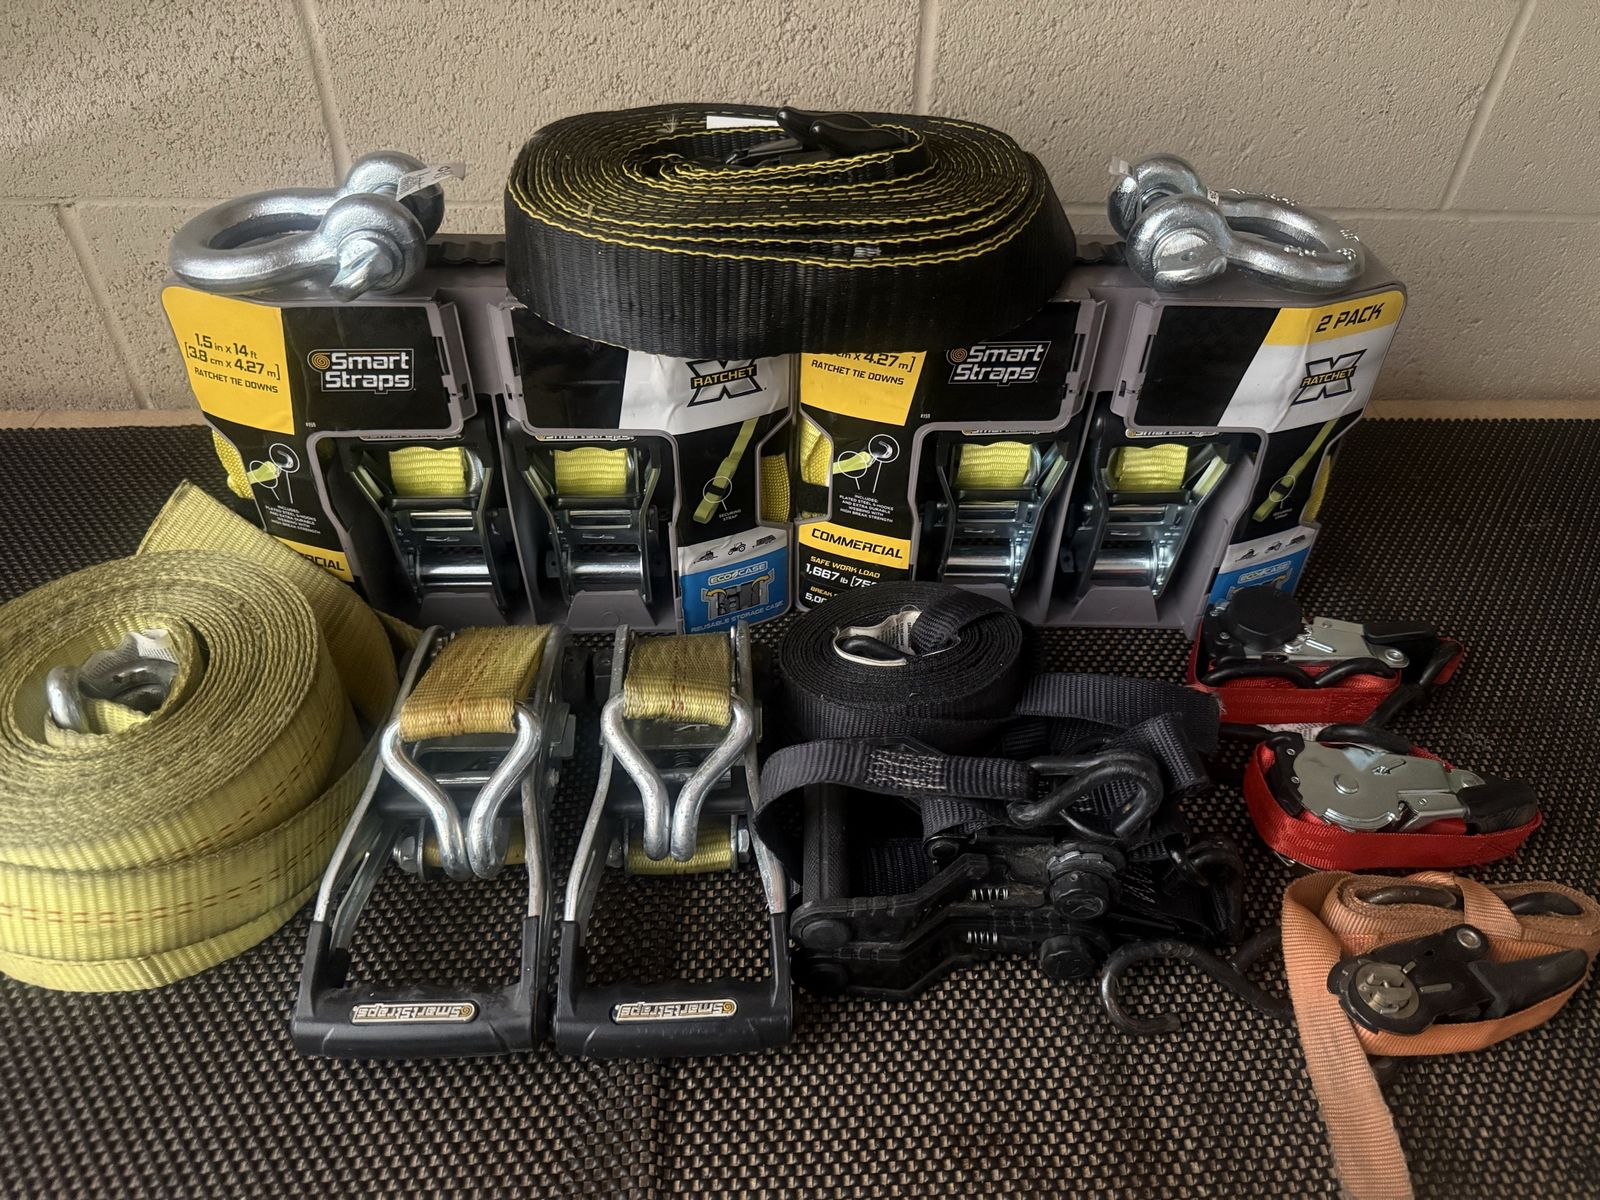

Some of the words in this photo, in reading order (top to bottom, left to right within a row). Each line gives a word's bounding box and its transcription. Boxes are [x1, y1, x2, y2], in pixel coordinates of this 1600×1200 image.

[1315, 314, 1333, 333] 2
[1333, 302, 1385, 330] PACK
[195, 333, 213, 349] 1.5
[214, 342, 224, 352] in
[233, 342, 249, 358] 14
[250, 350, 258, 360] ft
[966, 344, 1045, 362] Smart
[210, 358, 224, 367] cm
[234, 358, 265, 375] 4.27
[331, 352, 410, 370] Smart
[863, 352, 900, 368] 4.27
[194, 366, 228, 383] RATCHET
[229, 377, 243, 387] TIE
[244, 380, 279, 394] DOWNS
[325, 371, 410, 391] Straps
[693, 367, 755, 388] RATCHET
[811, 359, 851, 376] RATCHET
[852, 369, 865, 379] TIE
[867, 372, 905, 386] DOWNS
[953, 364, 1038, 383] Straps
[1302, 368, 1355, 387] RATCHET
[811, 528, 903, 559] COMMERCIAL
[805, 563, 840, 581] 1,667
[840, 576, 849, 585] lb
[810, 555, 830, 567] SAFE
[832, 561, 857, 574] WORK
[858, 568, 881, 579] LOAD
[810, 585, 833, 597] BREAK
[691, 617, 730, 633] REUSABLE
[731, 606, 764, 622] STORAGE
[765, 600, 784, 611] CASE
